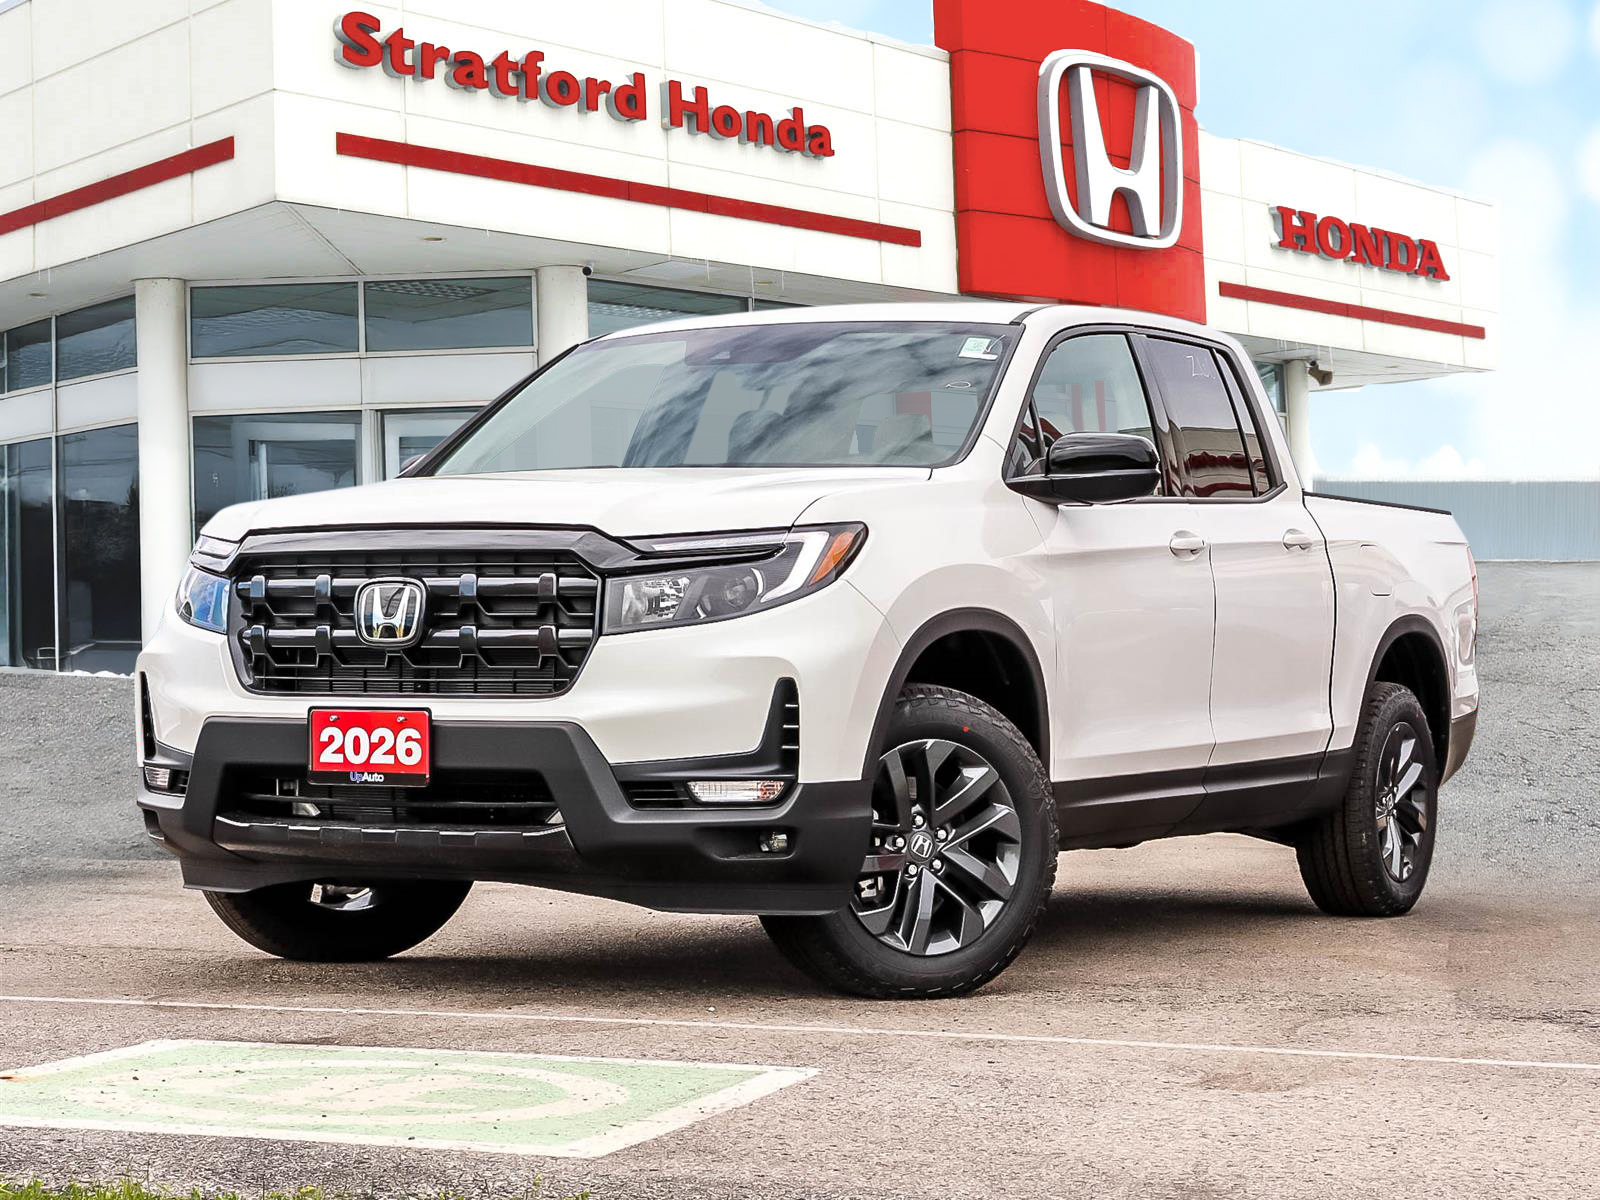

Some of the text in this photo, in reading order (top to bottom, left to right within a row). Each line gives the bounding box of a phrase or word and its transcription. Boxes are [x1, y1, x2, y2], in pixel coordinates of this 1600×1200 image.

[340, 11, 835, 157] Stratford Honda
[1274, 205, 1450, 282] HONDA
[319, 726, 422, 766] 2026
[350, 771, 384, 783] UpAuto
